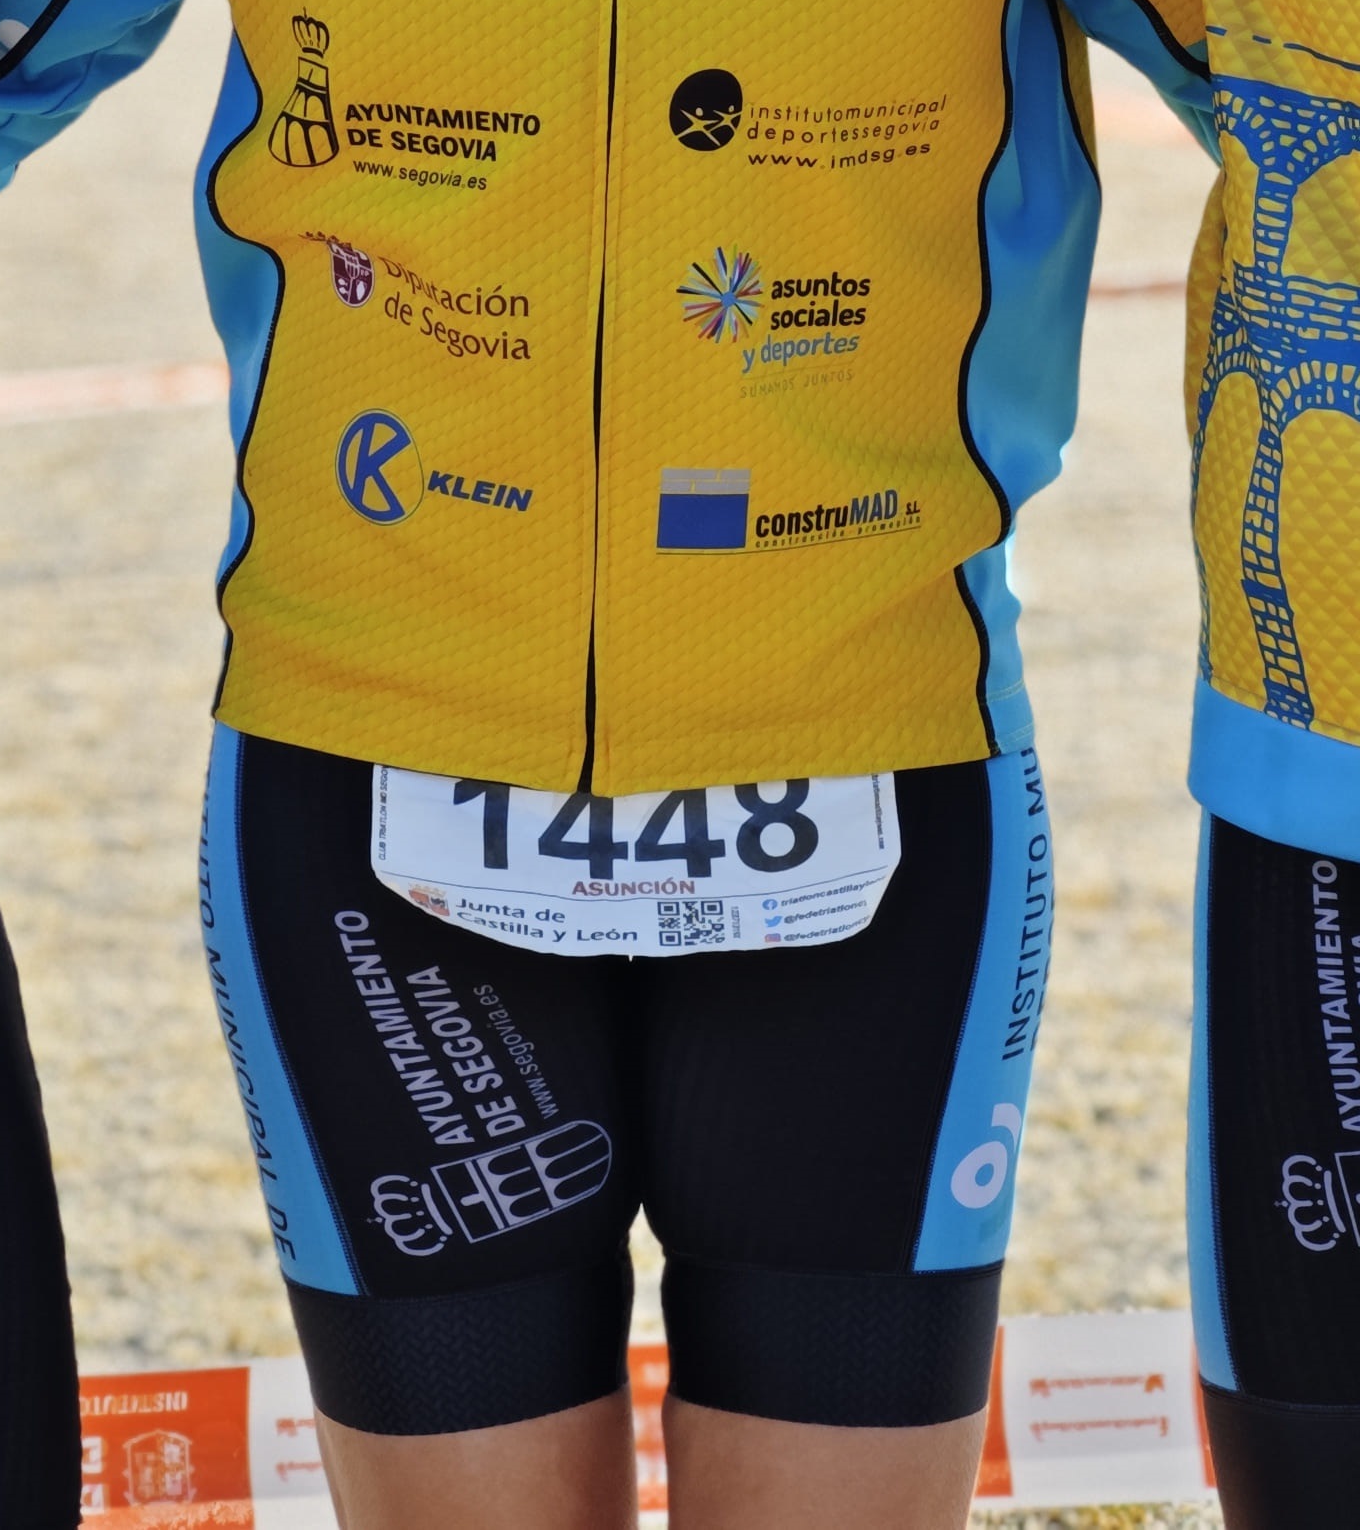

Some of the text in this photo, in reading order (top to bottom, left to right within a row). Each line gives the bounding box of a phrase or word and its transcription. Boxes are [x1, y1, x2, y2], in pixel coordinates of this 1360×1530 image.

[345, 103, 541, 136] AYUNTAMIENTO
[750, 94, 947, 123] institutomunicipal
[347, 128, 497, 162] DE SEGOVIA
[747, 119, 940, 145] deportessegovia
[748, 143, 931, 169] www.imdsg.es
[353, 159, 488, 190] www.segovia.es
[378, 256, 530, 317] Diputación
[771, 271, 871, 299] asuntos
[384, 291, 531, 360] de Segovia
[770, 300, 867, 330] sociales
[741, 332, 860, 374] y deportes
[427, 470, 533, 512] KLEIN
[756, 490, 898, 538] construMAD
[453, 777, 819, 880] 1448
[571, 877, 696, 898] ASUNCIÓN
[456, 898, 566, 923] Junta de
[456, 911, 638, 942] Castilla y León
[1002, 832, 1048, 1061] INSTITUTO
[334, 910, 475, 1146] AYUNTAMIENTO
[406, 966, 526, 1137] DE SEGOVIA
[473, 984, 559, 1120] www.segovia.es
